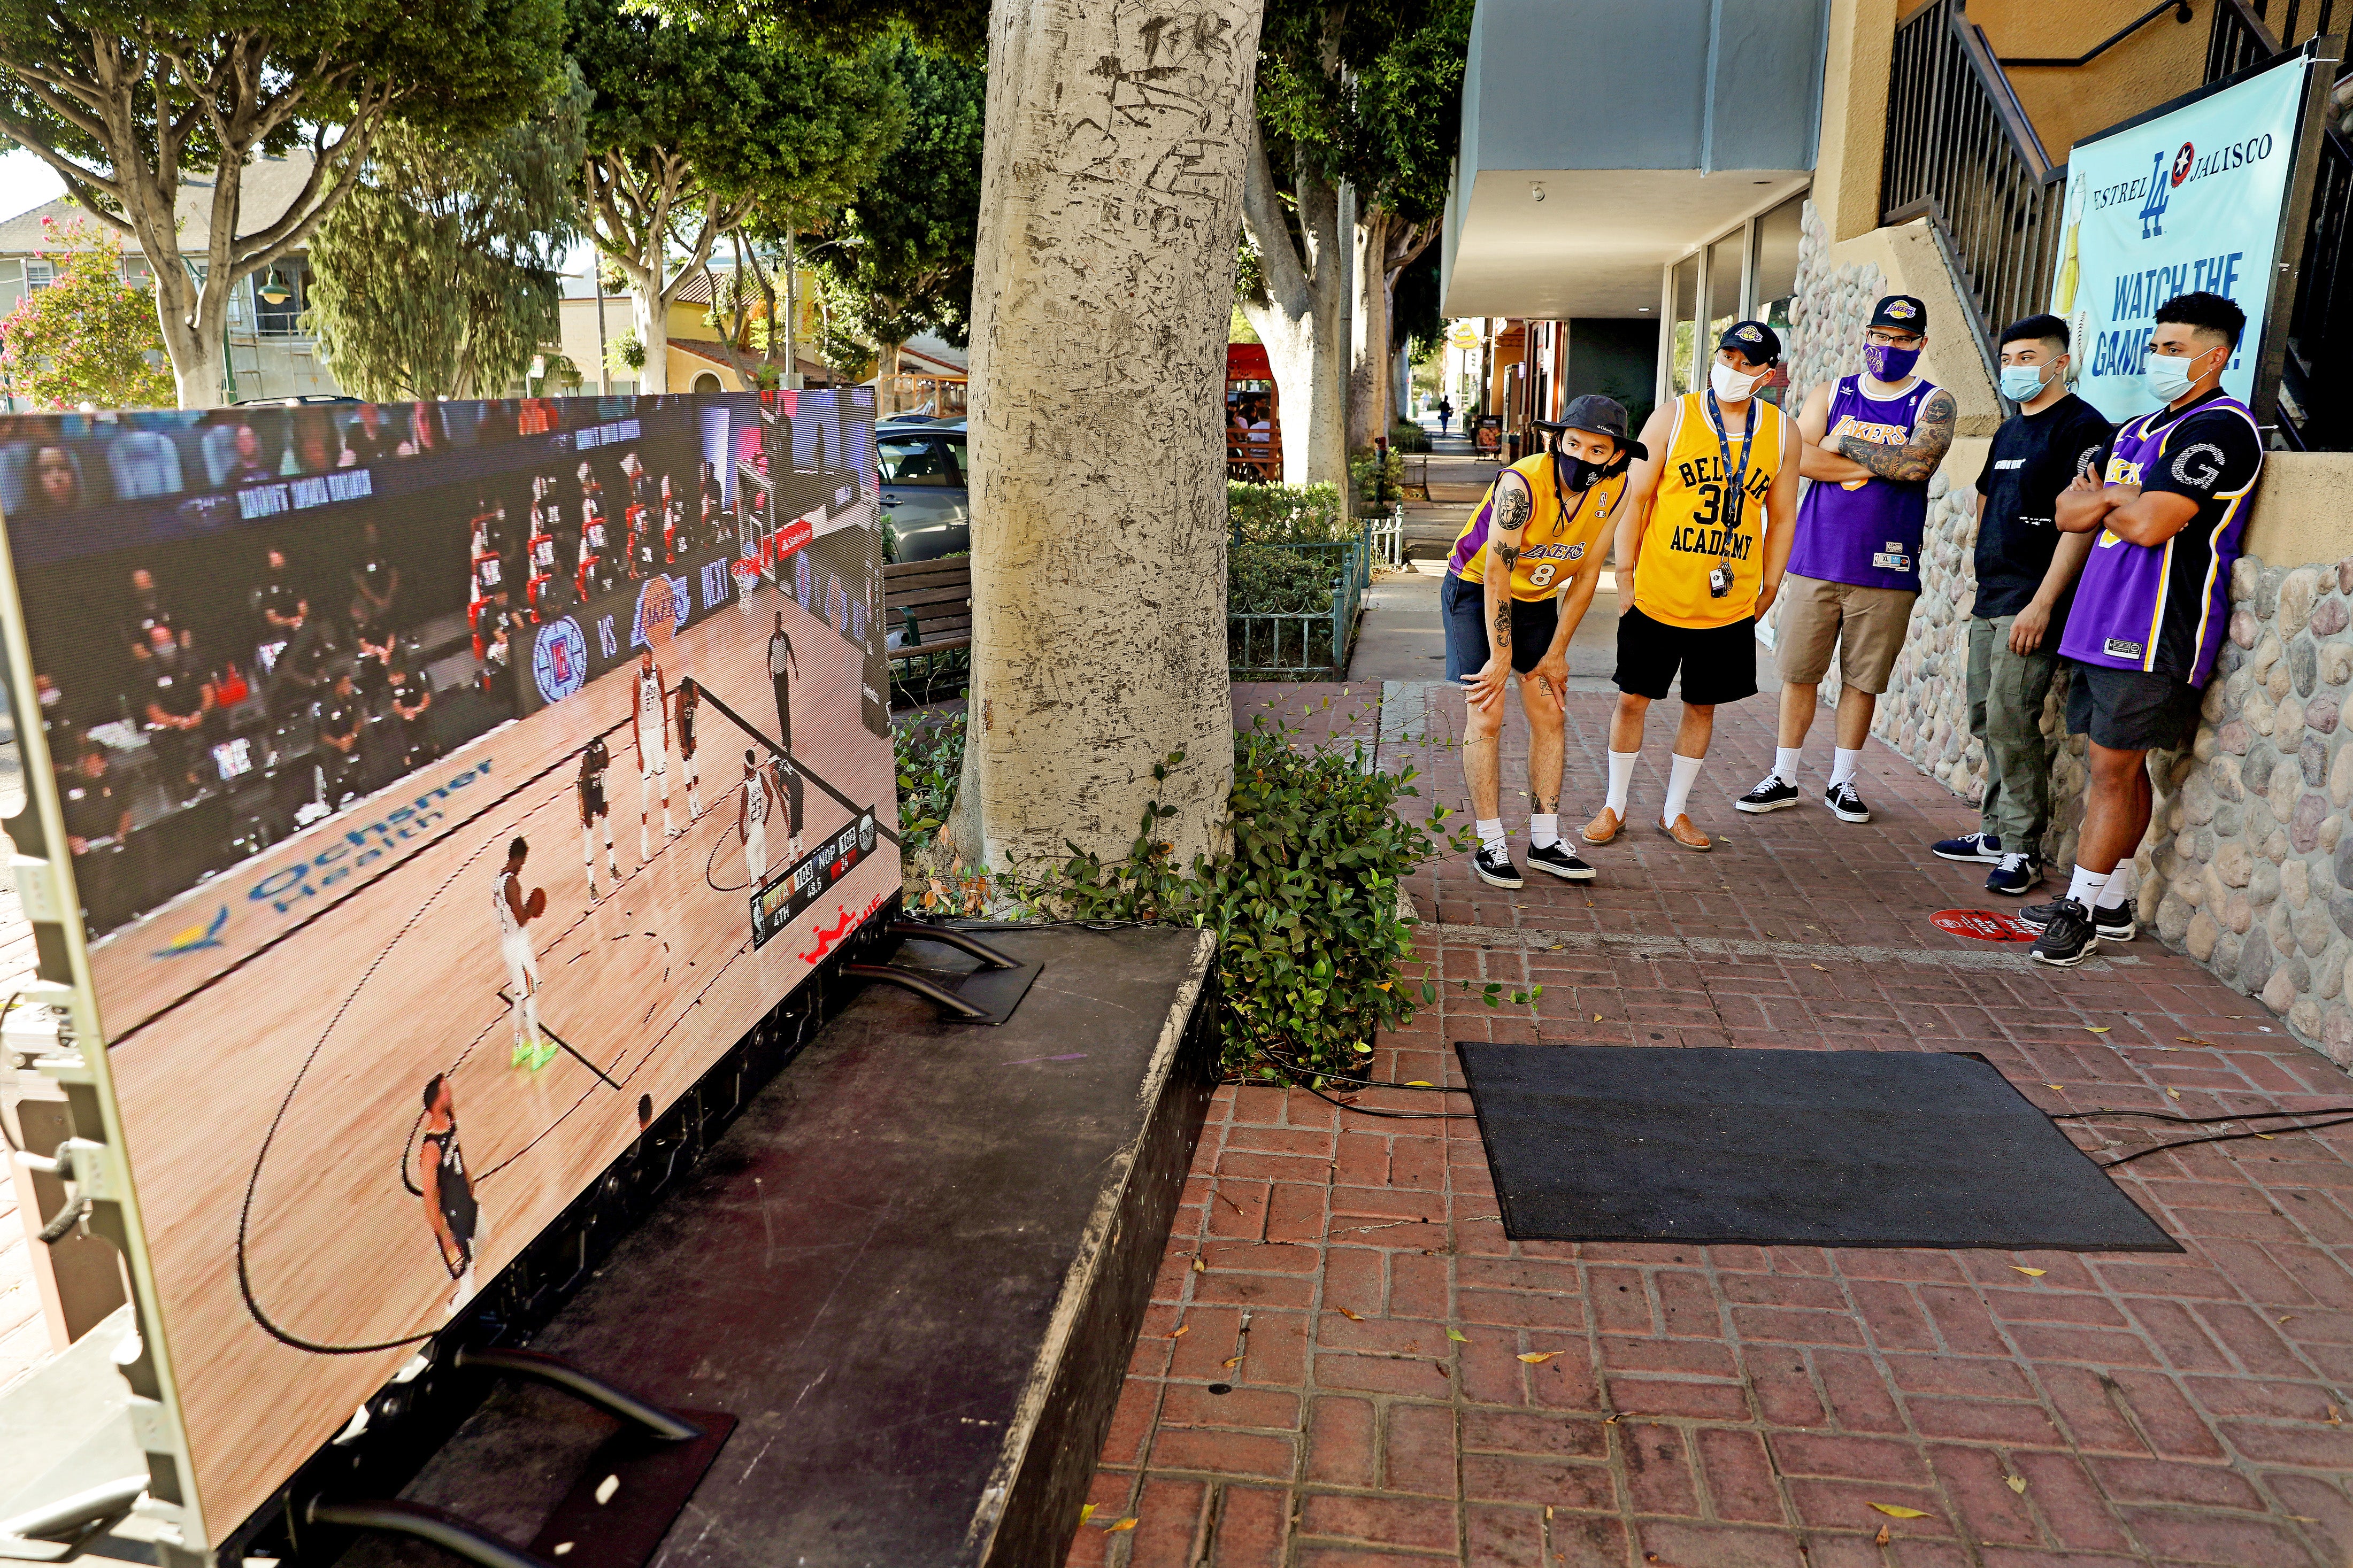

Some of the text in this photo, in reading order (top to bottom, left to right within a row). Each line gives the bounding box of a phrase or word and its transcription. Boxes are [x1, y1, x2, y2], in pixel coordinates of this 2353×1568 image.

[2190, 134, 2272, 182] JALISCO
[2112, 252, 2243, 321] WATCH THE
[1883, 304, 1916, 318] LAKERS
[1735, 328, 1763, 342] LAKERS
[2092, 327, 2154, 377] GAME
[1829, 414, 1908, 445] LAKERS
[1679, 457, 1723, 488] BEL
[2171, 443, 2225, 490] G
[1693, 484, 1745, 529] 30
[1519, 542, 1586, 560] LAKERS
[1529, 563, 1557, 586] 8
[770, 882, 790, 908] UTA
[796, 862, 813, 886] 103
[818, 845, 836, 870] NOP
[842, 829, 856, 852] 102
[774, 903, 789, 927] 4TH
[1985, 921, 2000, 930] STAY
